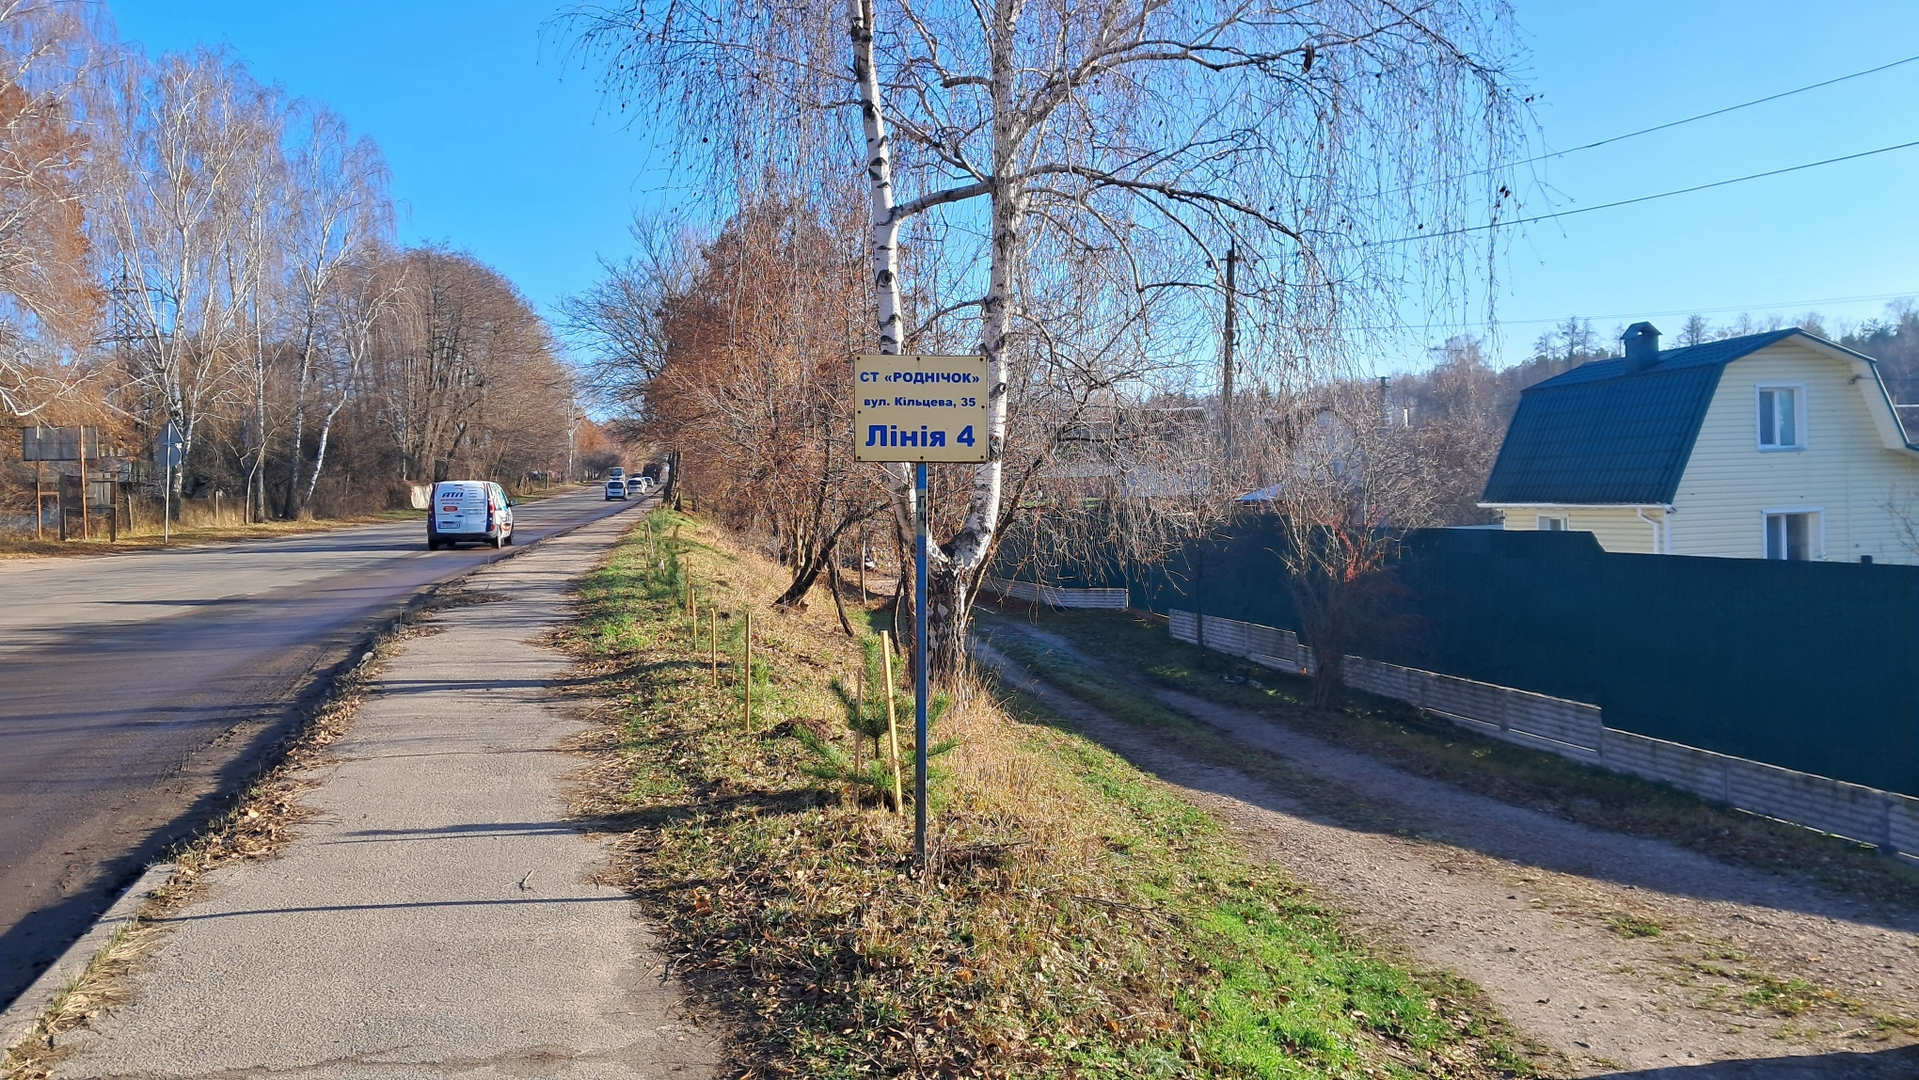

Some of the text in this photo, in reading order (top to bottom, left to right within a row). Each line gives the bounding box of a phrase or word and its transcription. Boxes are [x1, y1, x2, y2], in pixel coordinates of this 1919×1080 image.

[860, 372, 980, 384] СТ «РОДНІЧОК»
[864, 397, 976, 408] вул. Кільцева, 35
[865, 424, 976, 447] Лінія 4
